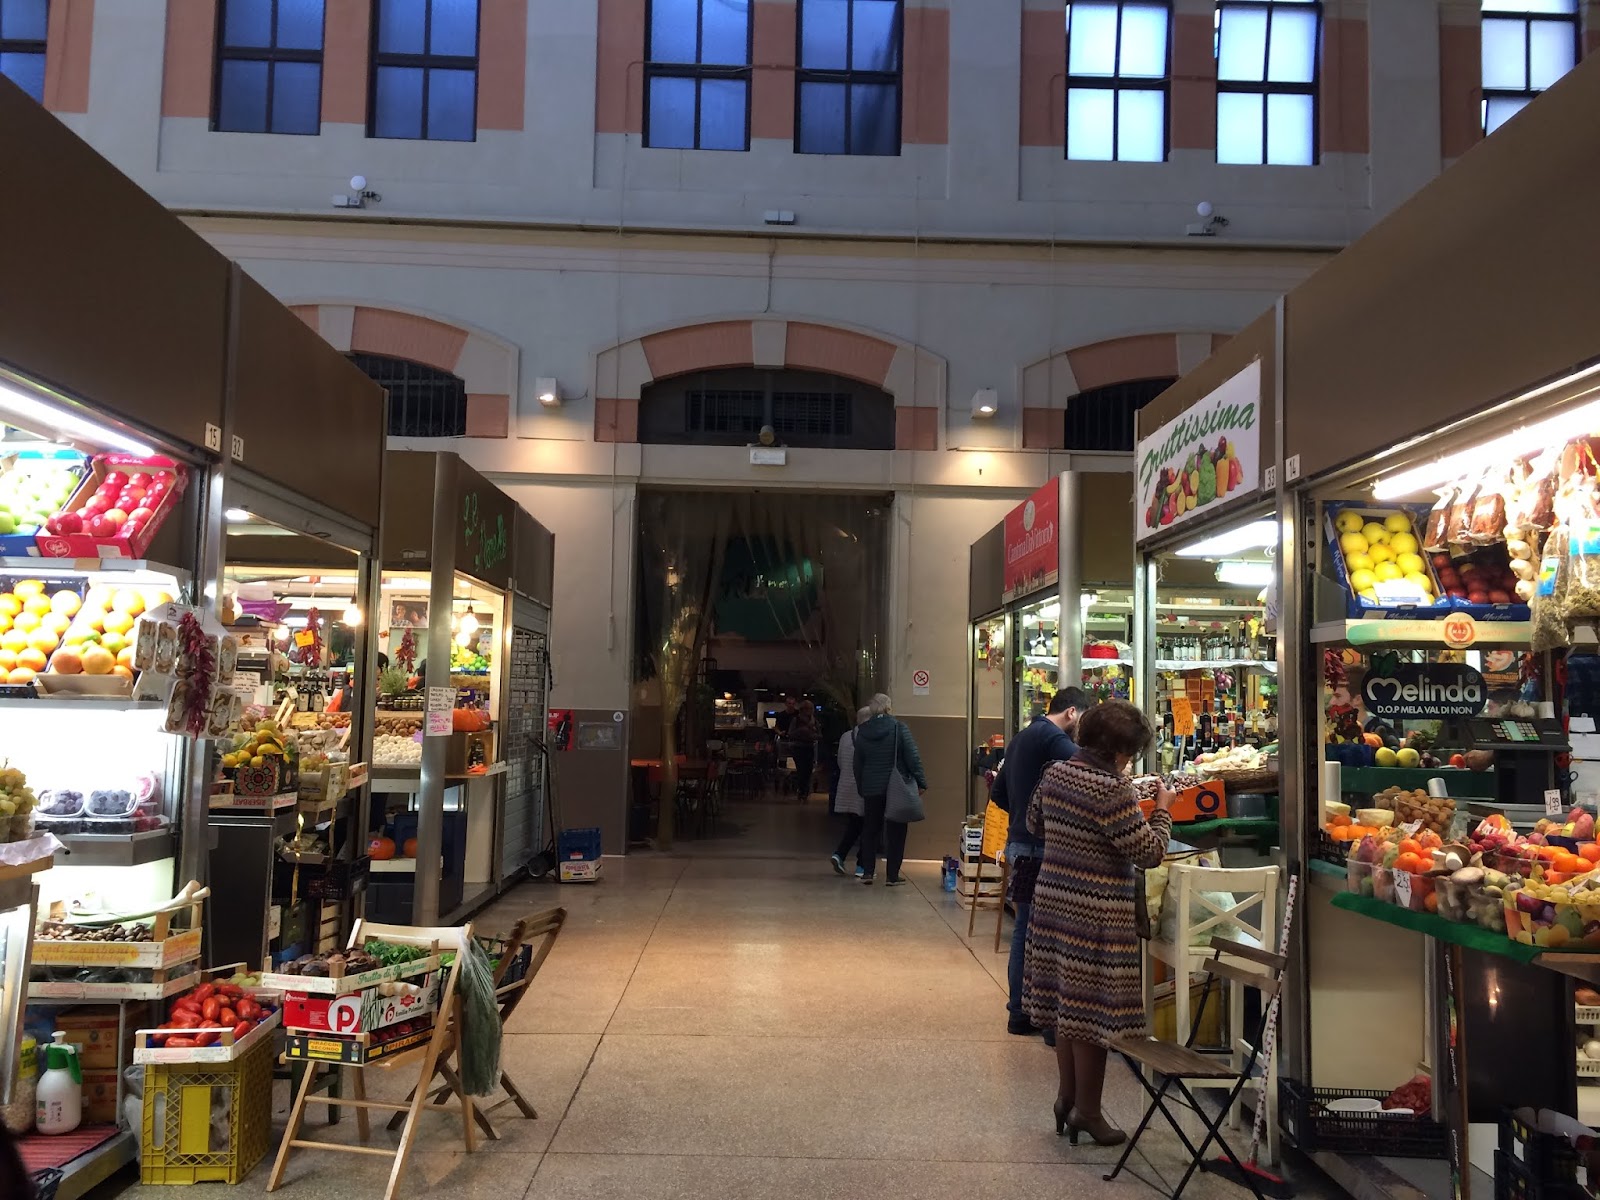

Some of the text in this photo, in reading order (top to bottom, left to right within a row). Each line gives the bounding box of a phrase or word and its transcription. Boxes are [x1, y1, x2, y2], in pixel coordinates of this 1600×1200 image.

[210, 427, 217, 447] 15
[233, 438, 241, 457] 32
[1139, 400, 1256, 504] Fruttissima
[1289, 461, 1296, 477] 14
[1267, 471, 1276, 488] 33
[1366, 674, 1481, 702] Melinda
[1377, 706, 1473, 715] D.O.P MELA VAL DI NON
